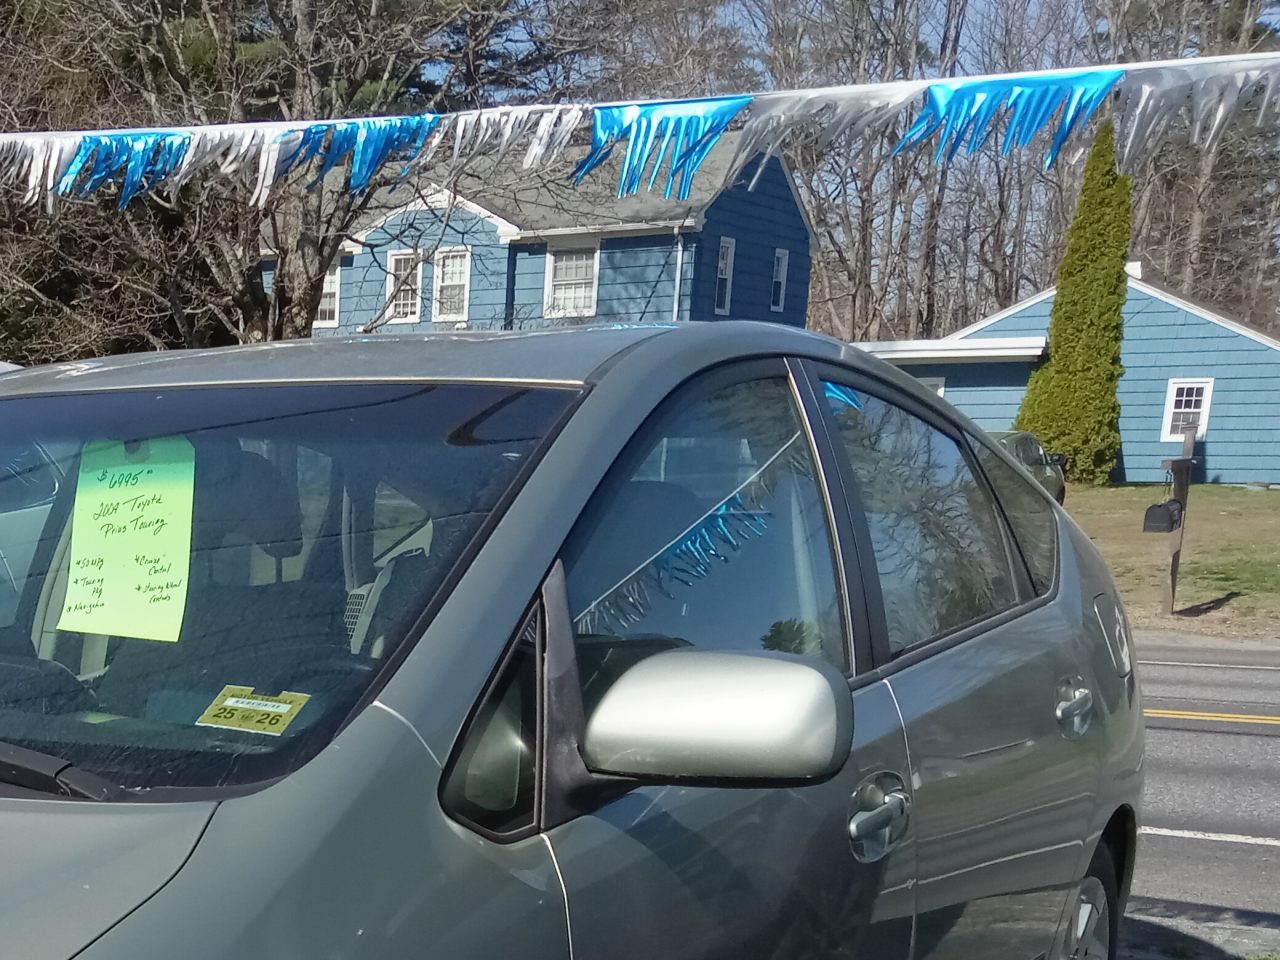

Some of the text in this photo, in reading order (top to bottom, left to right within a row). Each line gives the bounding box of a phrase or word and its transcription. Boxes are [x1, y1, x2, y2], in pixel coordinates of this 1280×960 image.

[122, 494, 164, 512] Toyota
[100, 515, 168, 538] Prius Touring
[212, 707, 238, 720] 25
[256, 712, 283, 726] 26
